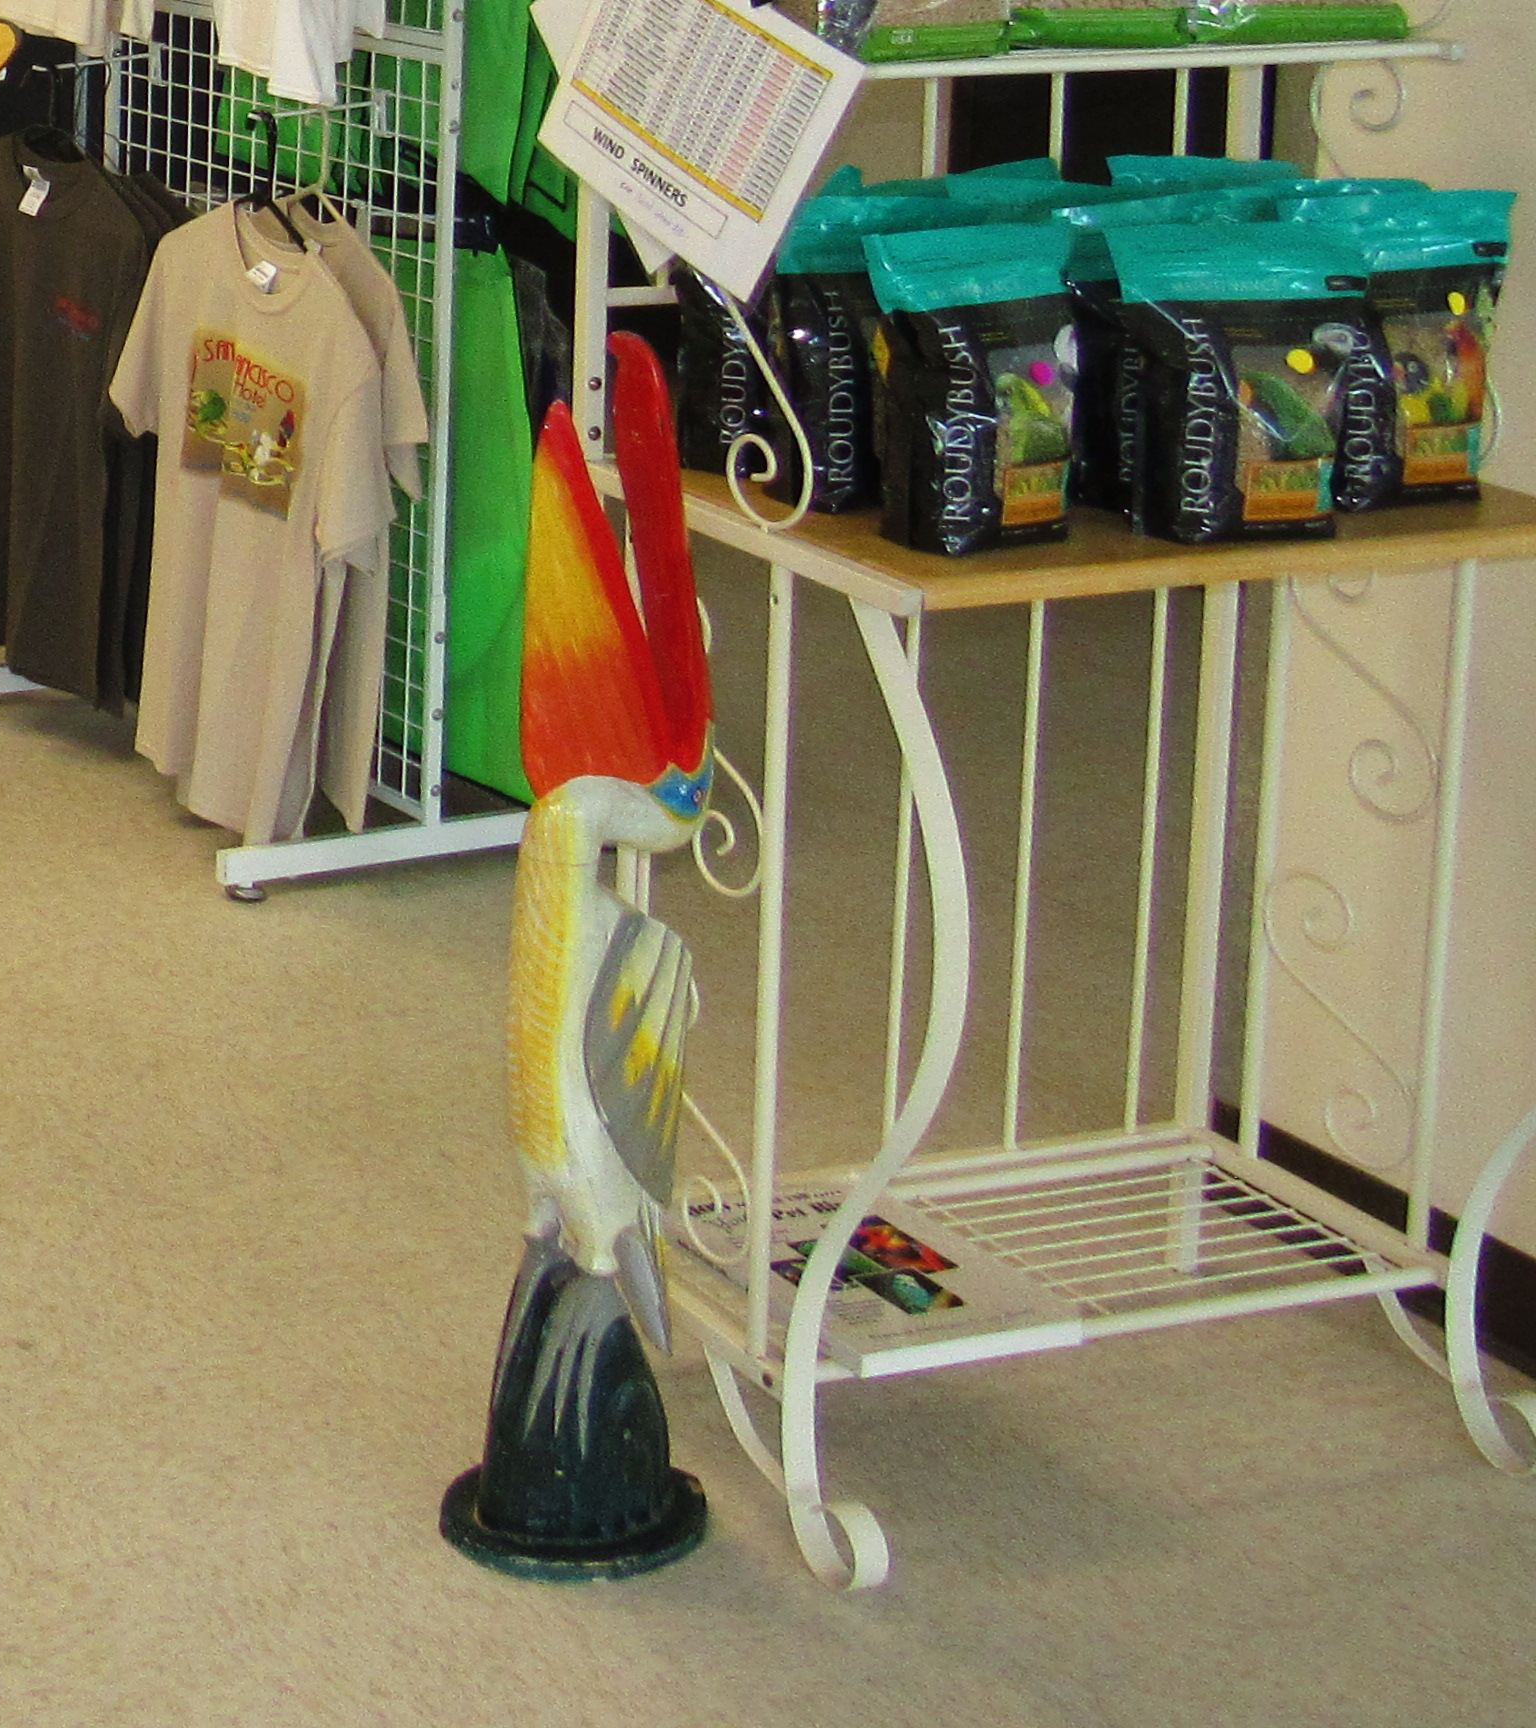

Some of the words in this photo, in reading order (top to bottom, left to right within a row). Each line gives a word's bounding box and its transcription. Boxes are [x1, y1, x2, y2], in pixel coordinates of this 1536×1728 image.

[593, 127, 625, 159] WIND
[630, 158, 688, 207] SPINNERS
[824, 291, 855, 483] ROUDYBUSH
[940, 325, 978, 522] ROUDYBUSH
[1180, 318, 1218, 514] ROUDYBUSH
